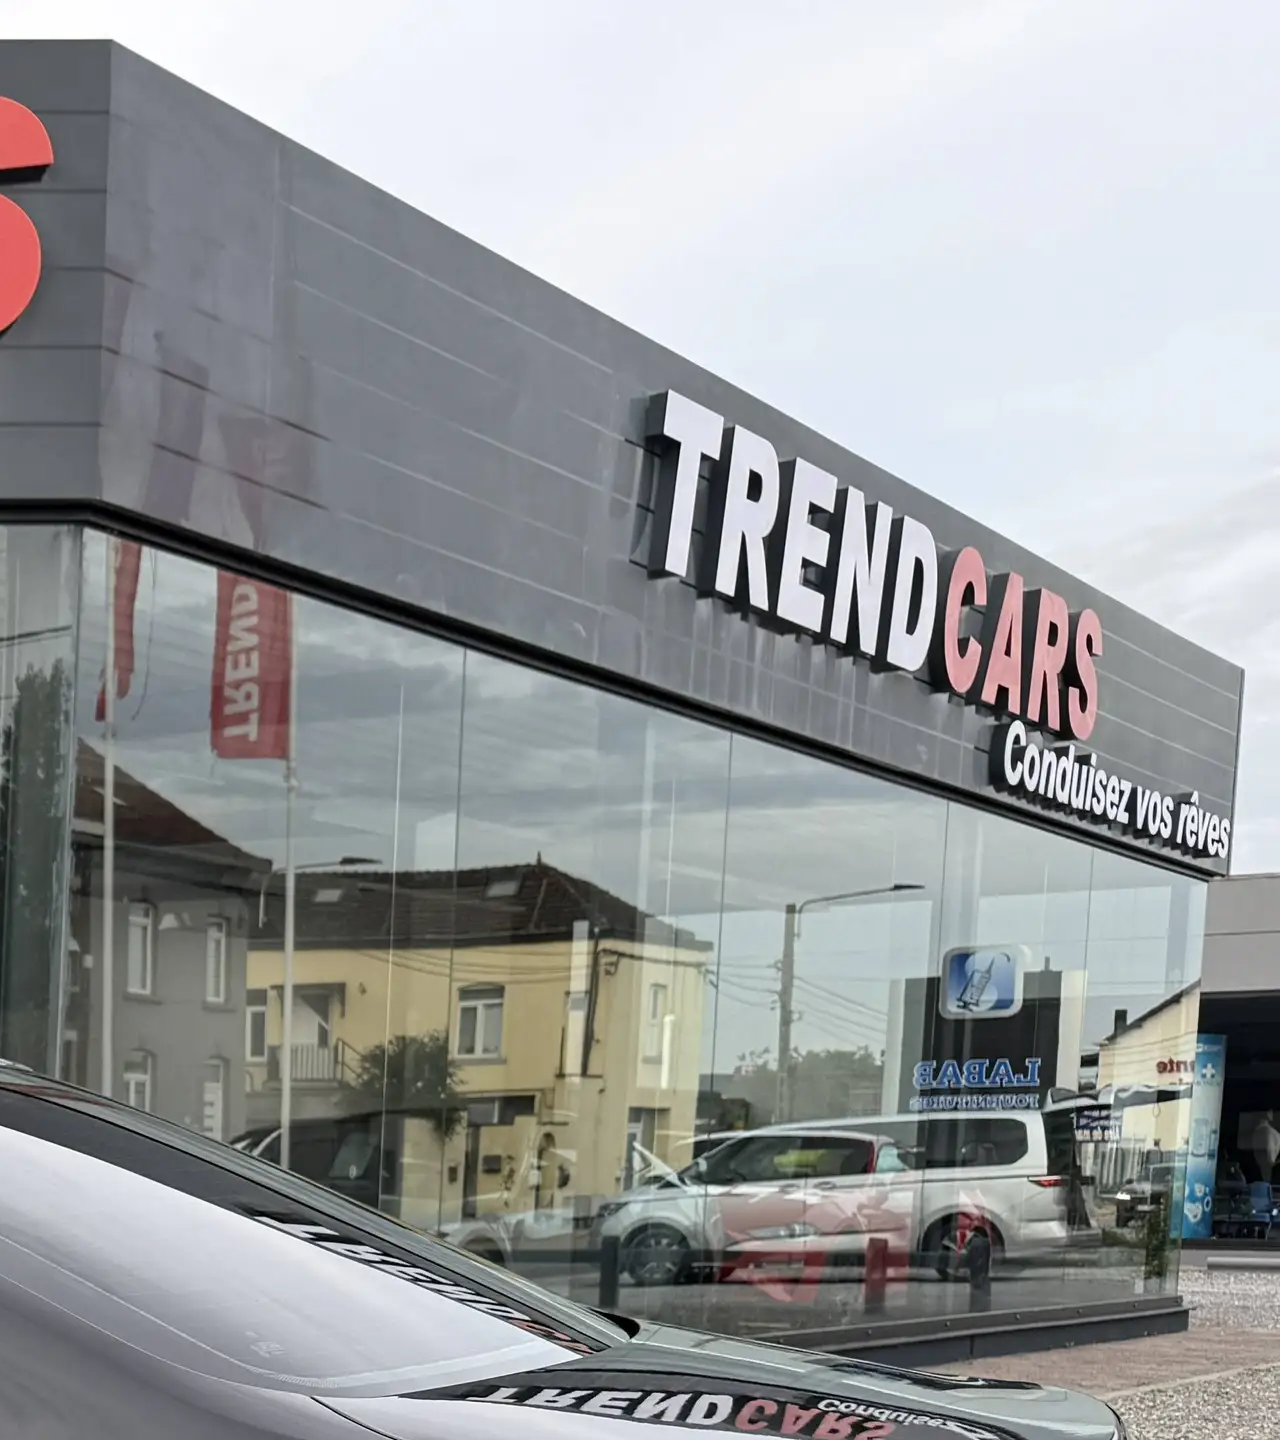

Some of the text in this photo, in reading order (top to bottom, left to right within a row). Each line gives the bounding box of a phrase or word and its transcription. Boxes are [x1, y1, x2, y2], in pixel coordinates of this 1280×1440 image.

[662, 388, 1103, 740] TREND CARS
[1004, 719, 1231, 859] Conduisez vos rêves
